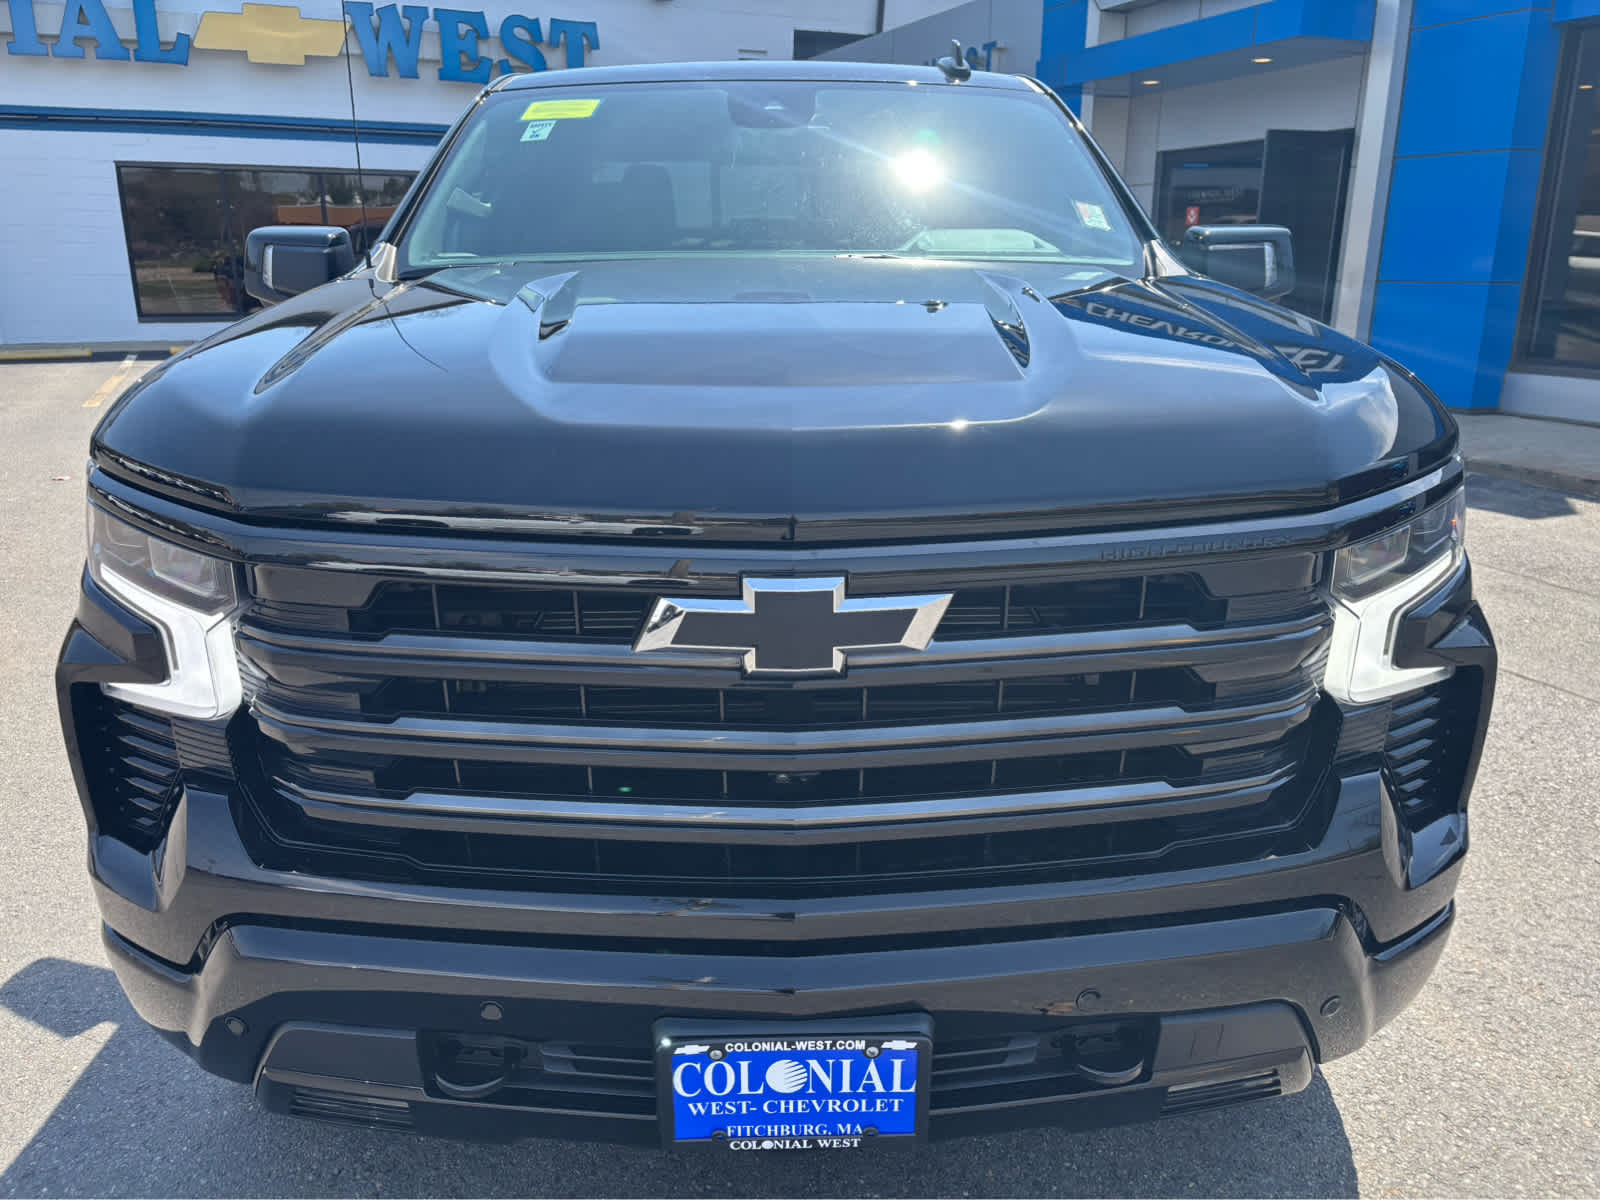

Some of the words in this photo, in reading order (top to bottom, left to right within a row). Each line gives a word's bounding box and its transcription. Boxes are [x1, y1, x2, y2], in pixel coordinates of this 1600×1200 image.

[6, 0, 190, 66] IAL
[344, 0, 600, 84] WEST
[725, 1040, 866, 1053] COLONIAL-WEST.COM
[673, 1059, 916, 1097] COLONIAL
[688, 1101, 757, 1117] WEST-
[762, 1098, 904, 1115] CHEVROLET
[836, 1123, 863, 1135] MA
[729, 1138, 812, 1150] COLONIAL
[817, 1138, 861, 1149] WEST
